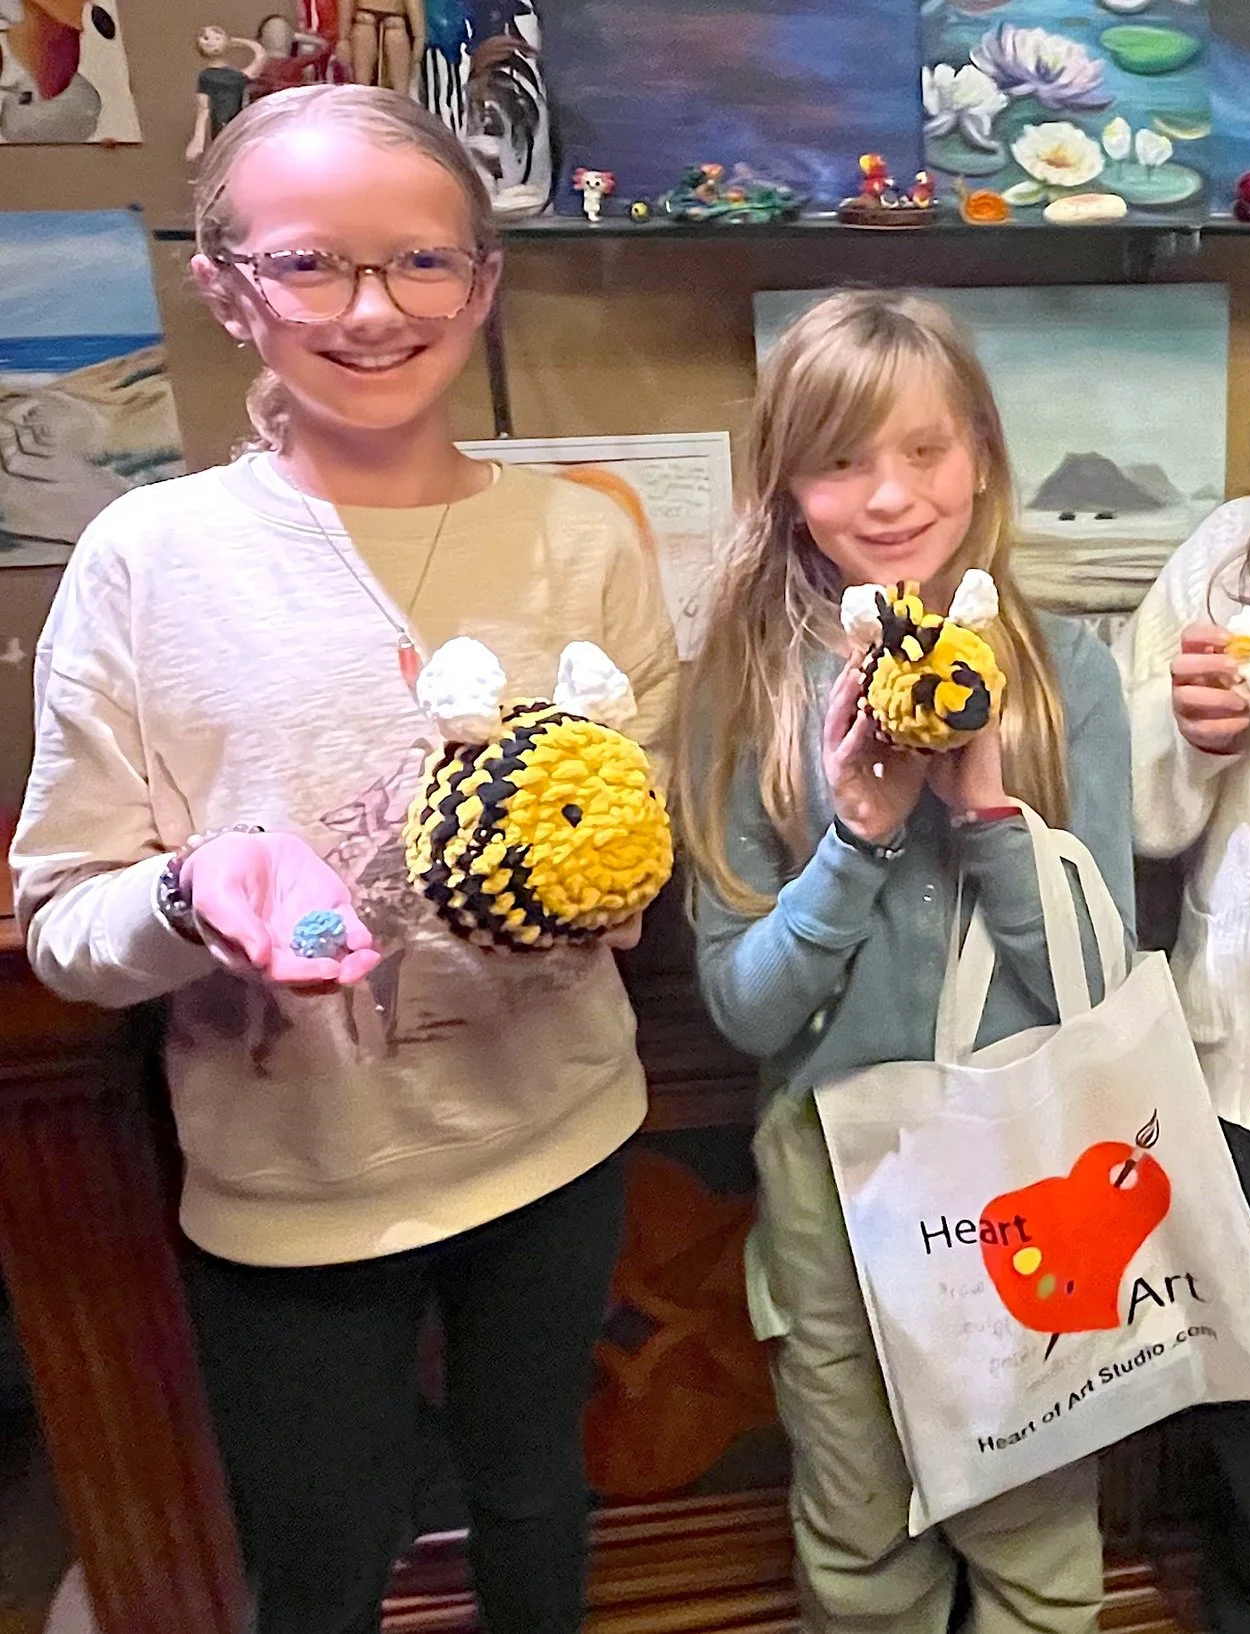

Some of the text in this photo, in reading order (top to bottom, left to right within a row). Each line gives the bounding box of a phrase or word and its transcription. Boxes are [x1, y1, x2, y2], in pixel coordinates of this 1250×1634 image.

[919, 1215, 1033, 1255] Heart
[1127, 1272, 1209, 1326] Art
[977, 1420, 1036, 1453] Heart
[1041, 1402, 1061, 1424] of
[1068, 1379, 1095, 1411] Art
[1098, 1343, 1165, 1384] Studio
